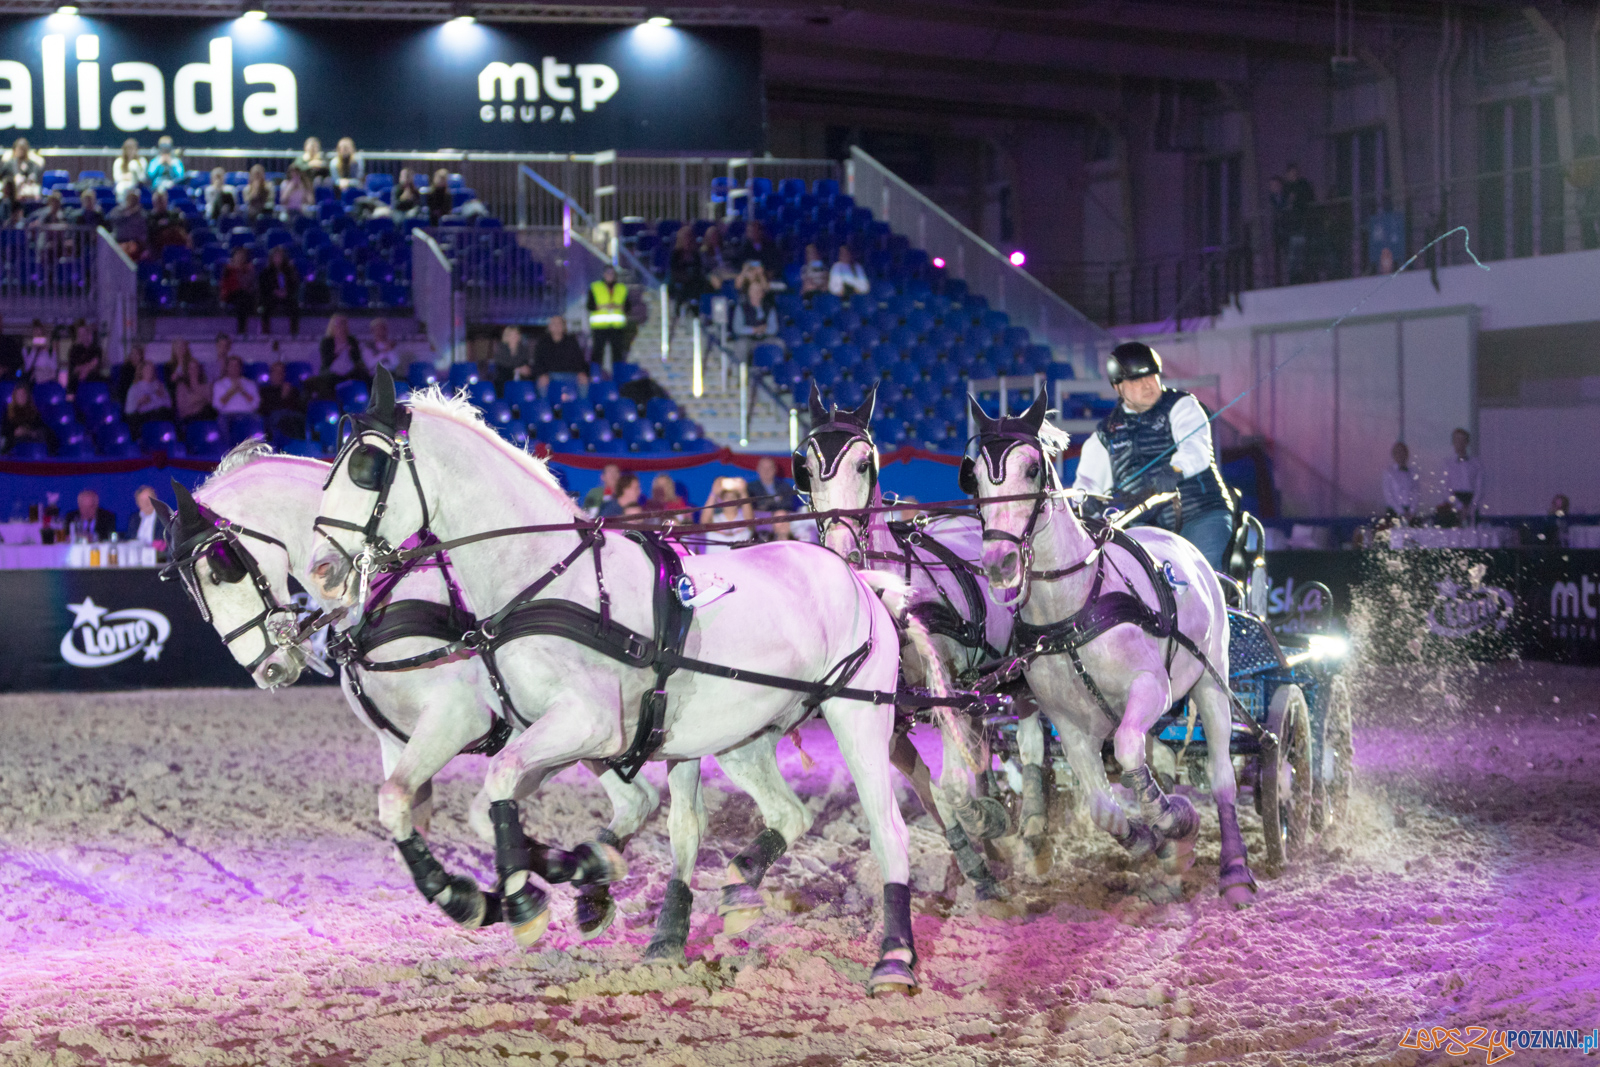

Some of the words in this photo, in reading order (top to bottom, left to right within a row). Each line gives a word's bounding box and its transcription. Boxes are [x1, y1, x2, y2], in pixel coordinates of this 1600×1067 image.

[0, 34, 298, 133] aliada
[478, 56, 620, 112] mtp
[480, 104, 576, 124] GRUPA
[1551, 574, 1600, 619] mt
[81, 619, 150, 656] LOTTO
